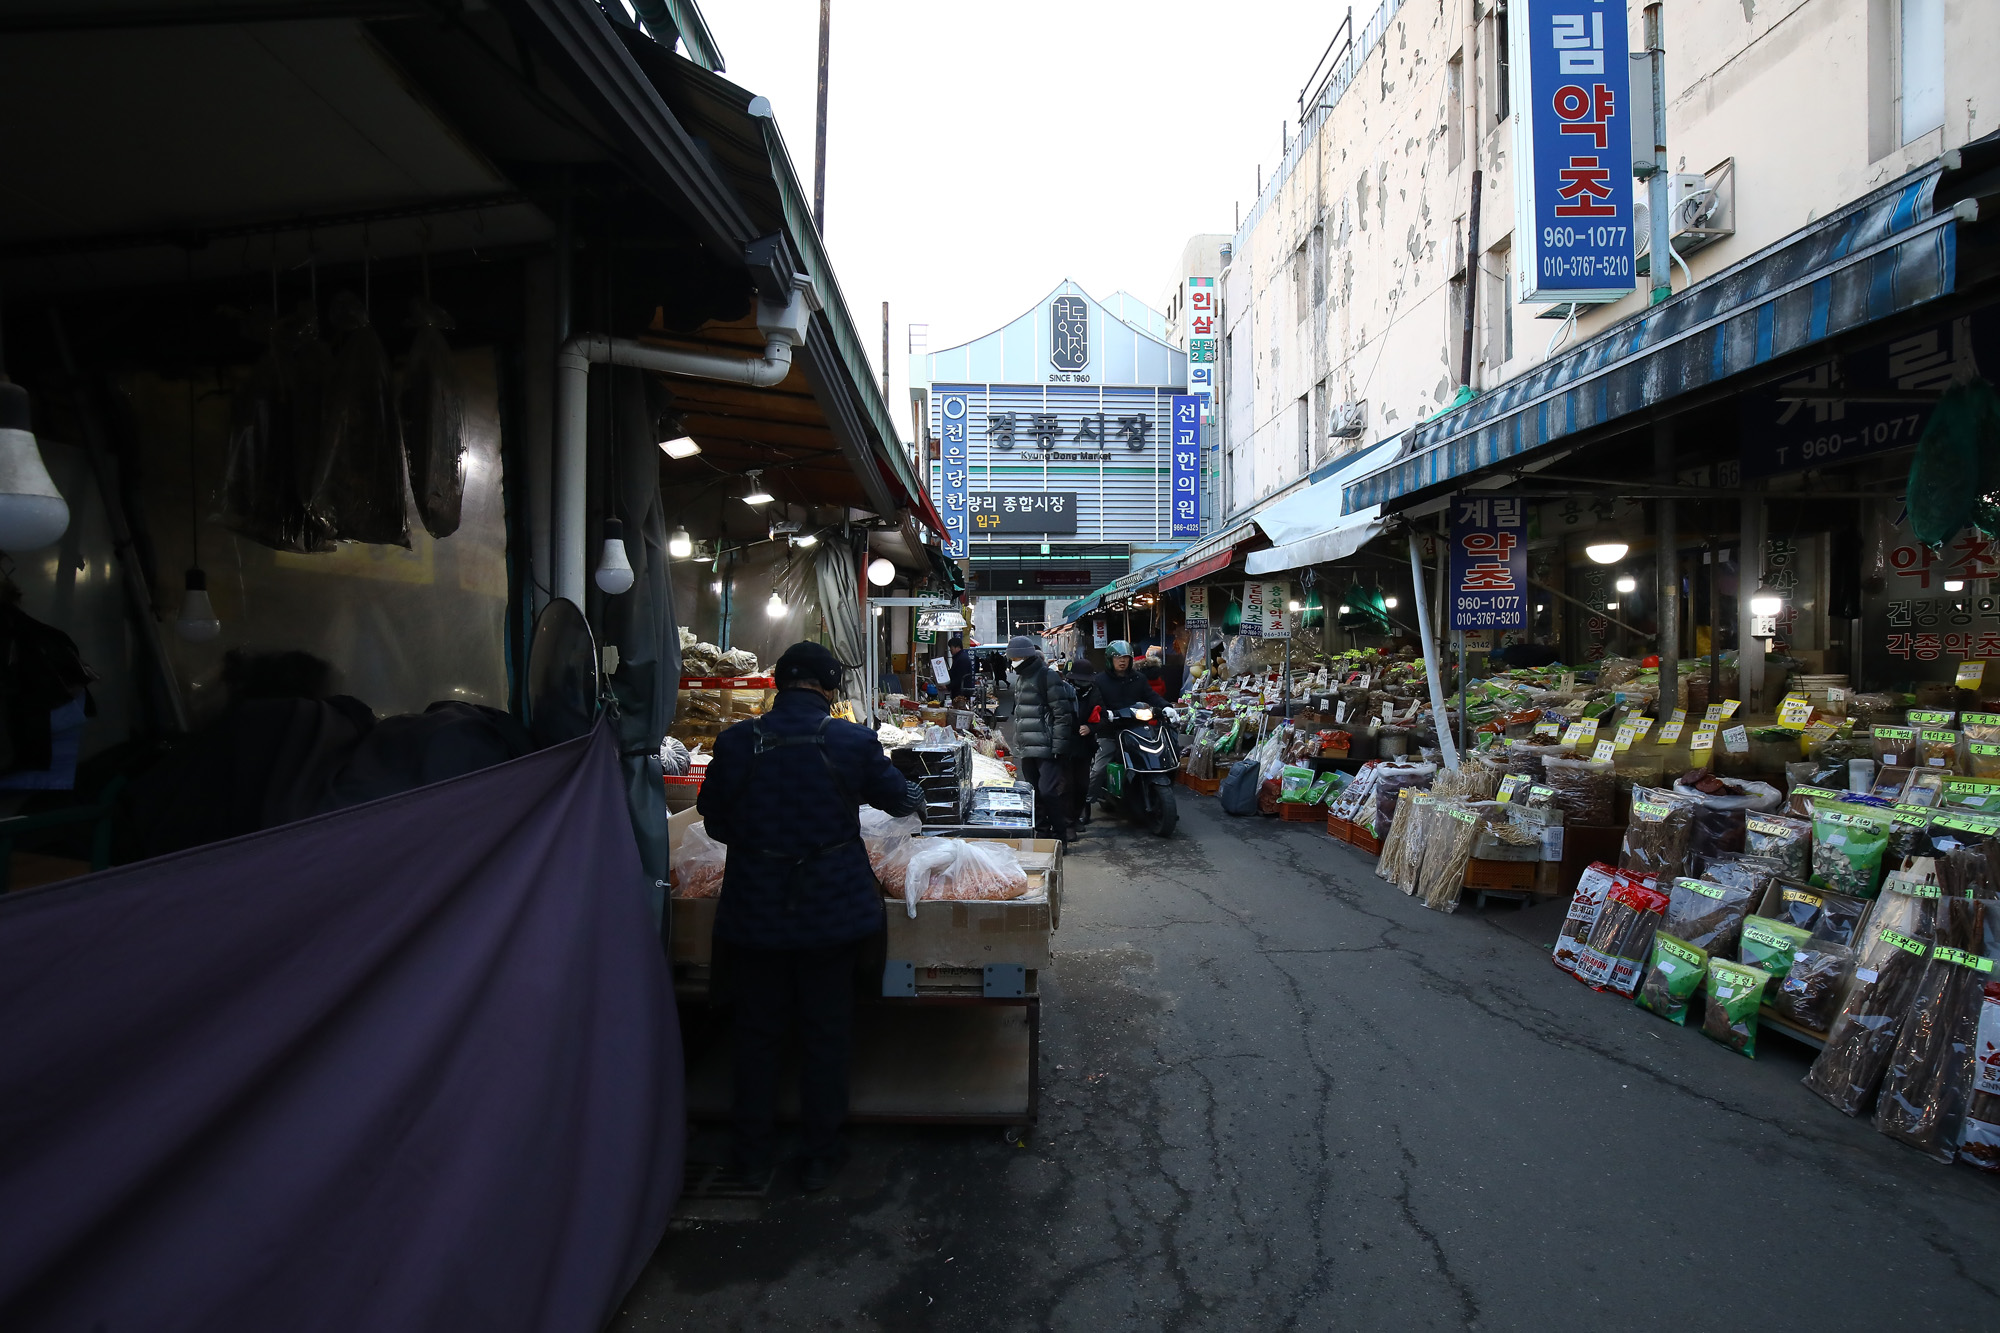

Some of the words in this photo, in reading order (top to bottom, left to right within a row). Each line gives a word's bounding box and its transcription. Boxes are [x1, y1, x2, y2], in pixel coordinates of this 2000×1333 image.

[1552, 0, 1616, 218] 림약초
[1544, 226, 1627, 248] 960-1077
[1543, 255, 1629, 277] 010-3767-5210
[1191, 292, 1214, 334] 인삼
[1049, 374, 1071, 382] SINCE
[1073, 374, 1090, 382] 1960
[984, 410, 1153, 453] 경동시장
[1776, 447, 1790, 465] T
[1802, 414, 1920, 460] 960-1077
[1021, 451, 1050, 461] Kyung
[1053, 451, 1078, 461] Dong
[1080, 451, 1112, 461] Market
[1176, 403, 1197, 520] 선교한의원
[1719, 461, 1739, 487] 66
[945, 423, 967, 558] 천은당한의원
[1002, 496, 1065, 512] 종합시장
[1458, 497, 1521, 528] 계림
[976, 514, 1001, 528] 입구
[1173, 523, 1199, 533] 966-4325
[1460, 532, 1517, 592] 약초
[1890, 537, 1999, 589] 약초
[1457, 596, 1520, 611] 960-1077
[1456, 612, 1520, 626] 010-3767-5210
[1452, 641, 1490, 649] 9-3142
